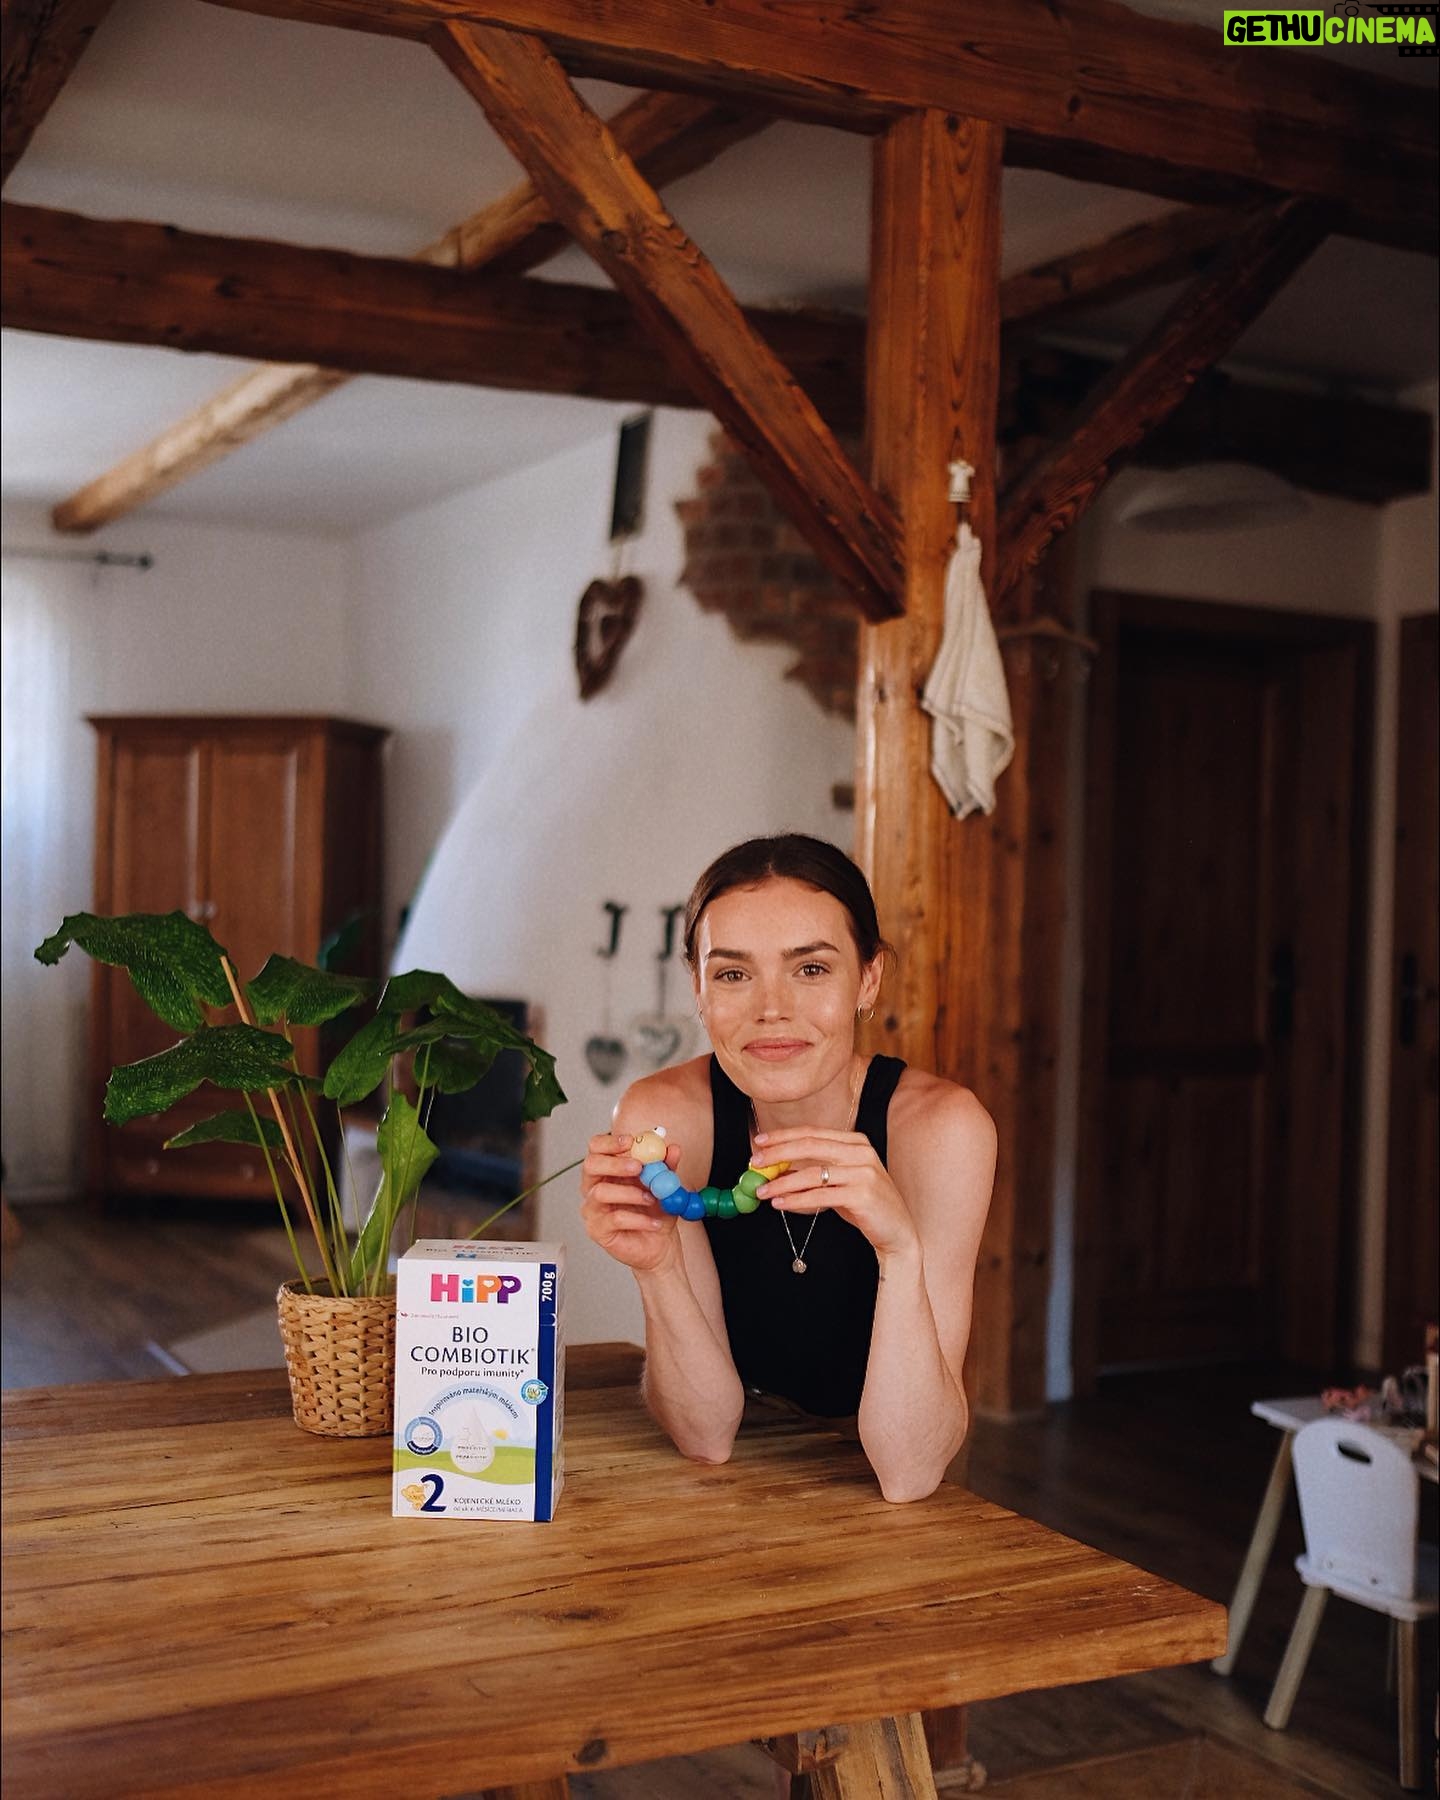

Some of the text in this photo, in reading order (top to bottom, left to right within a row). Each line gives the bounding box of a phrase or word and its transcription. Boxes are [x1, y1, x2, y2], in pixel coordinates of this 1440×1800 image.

[430, 1273, 522, 1304] HiPP
[452, 1326, 488, 1344] BIO
[421, 1366, 438, 1376] Pro
[439, 1368, 480, 1379] podporu
[420, 1473, 447, 1512] 2
